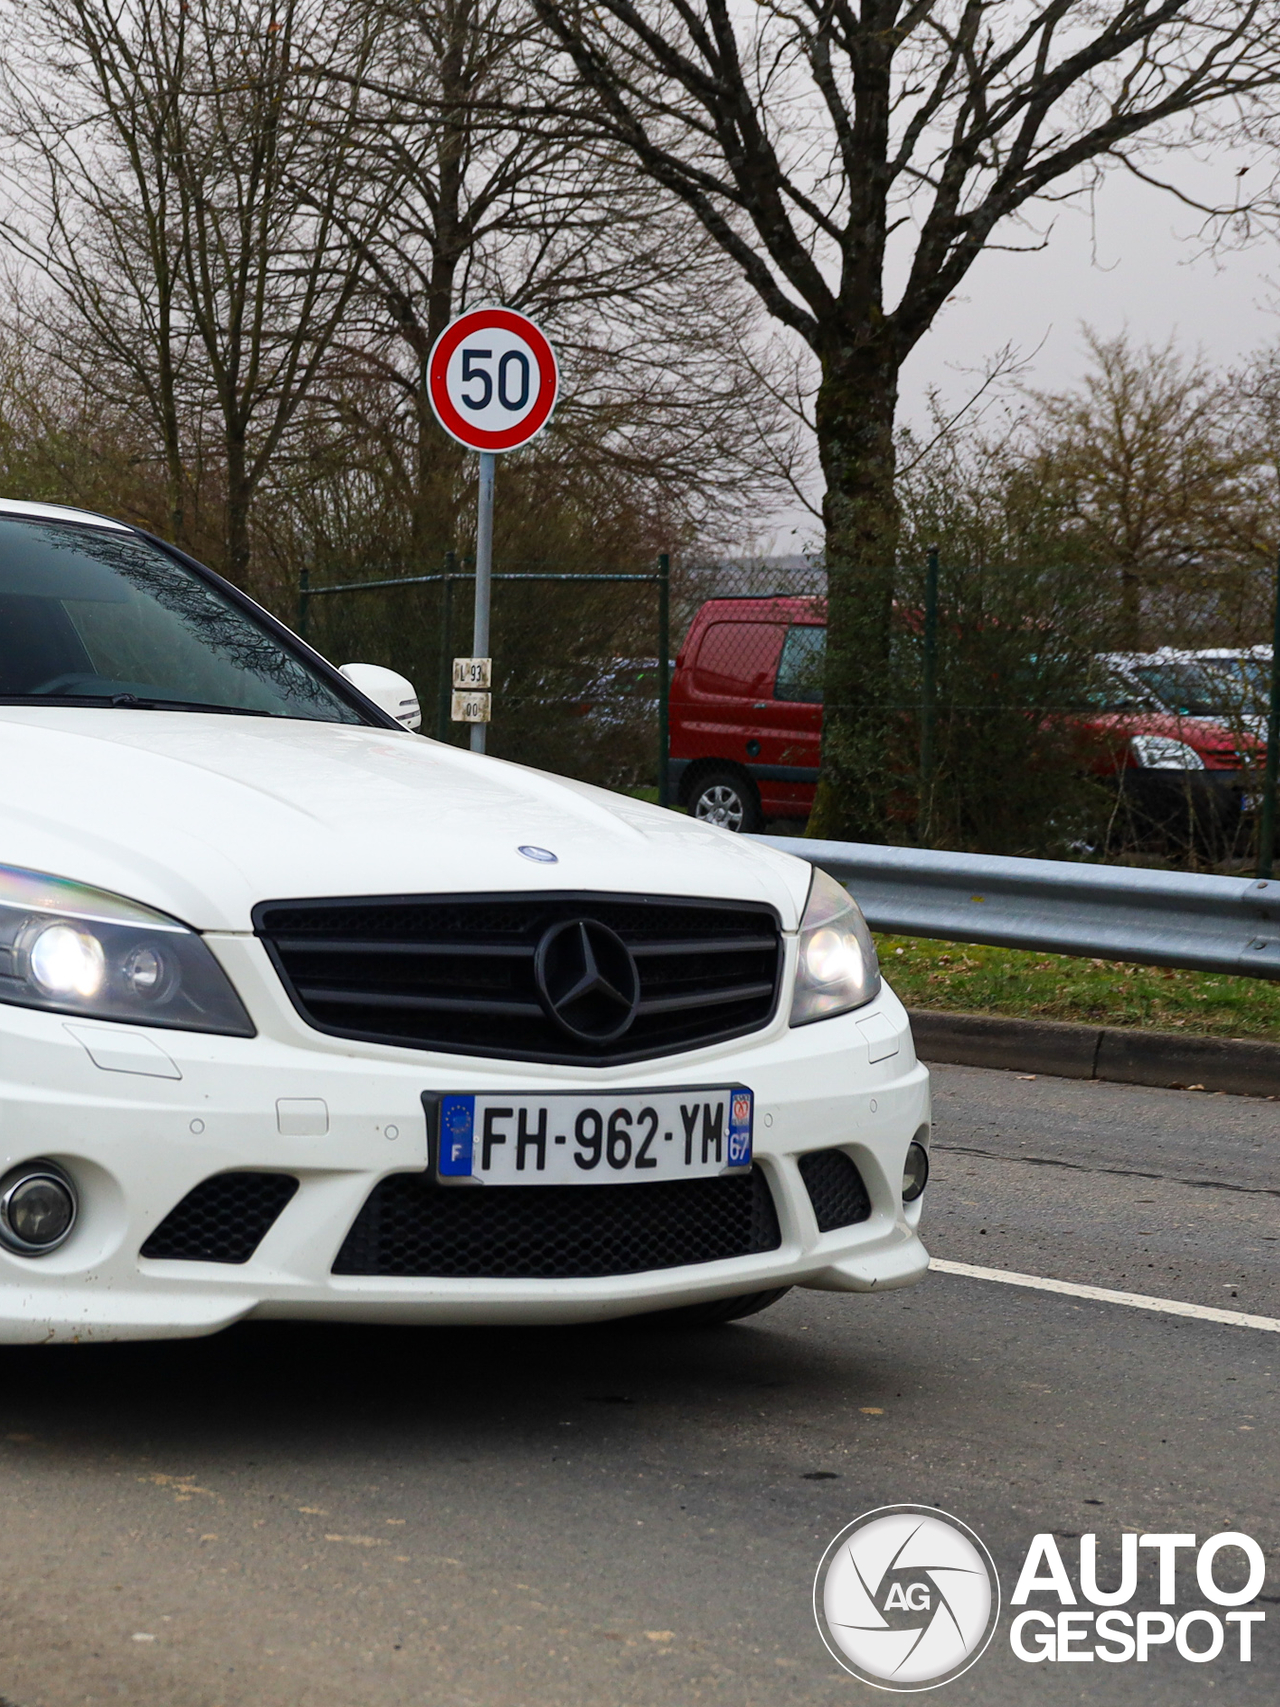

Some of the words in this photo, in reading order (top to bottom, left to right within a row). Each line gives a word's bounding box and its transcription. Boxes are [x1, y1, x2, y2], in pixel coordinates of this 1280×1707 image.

[461, 349, 530, 411] 50
[460, 665, 465, 681] L
[471, 665, 482, 681] 93
[466, 703, 478, 716] 00
[451, 1144, 462, 1162] F
[482, 1102, 724, 1171] FH-962-YM
[730, 1132, 750, 1160] 67
